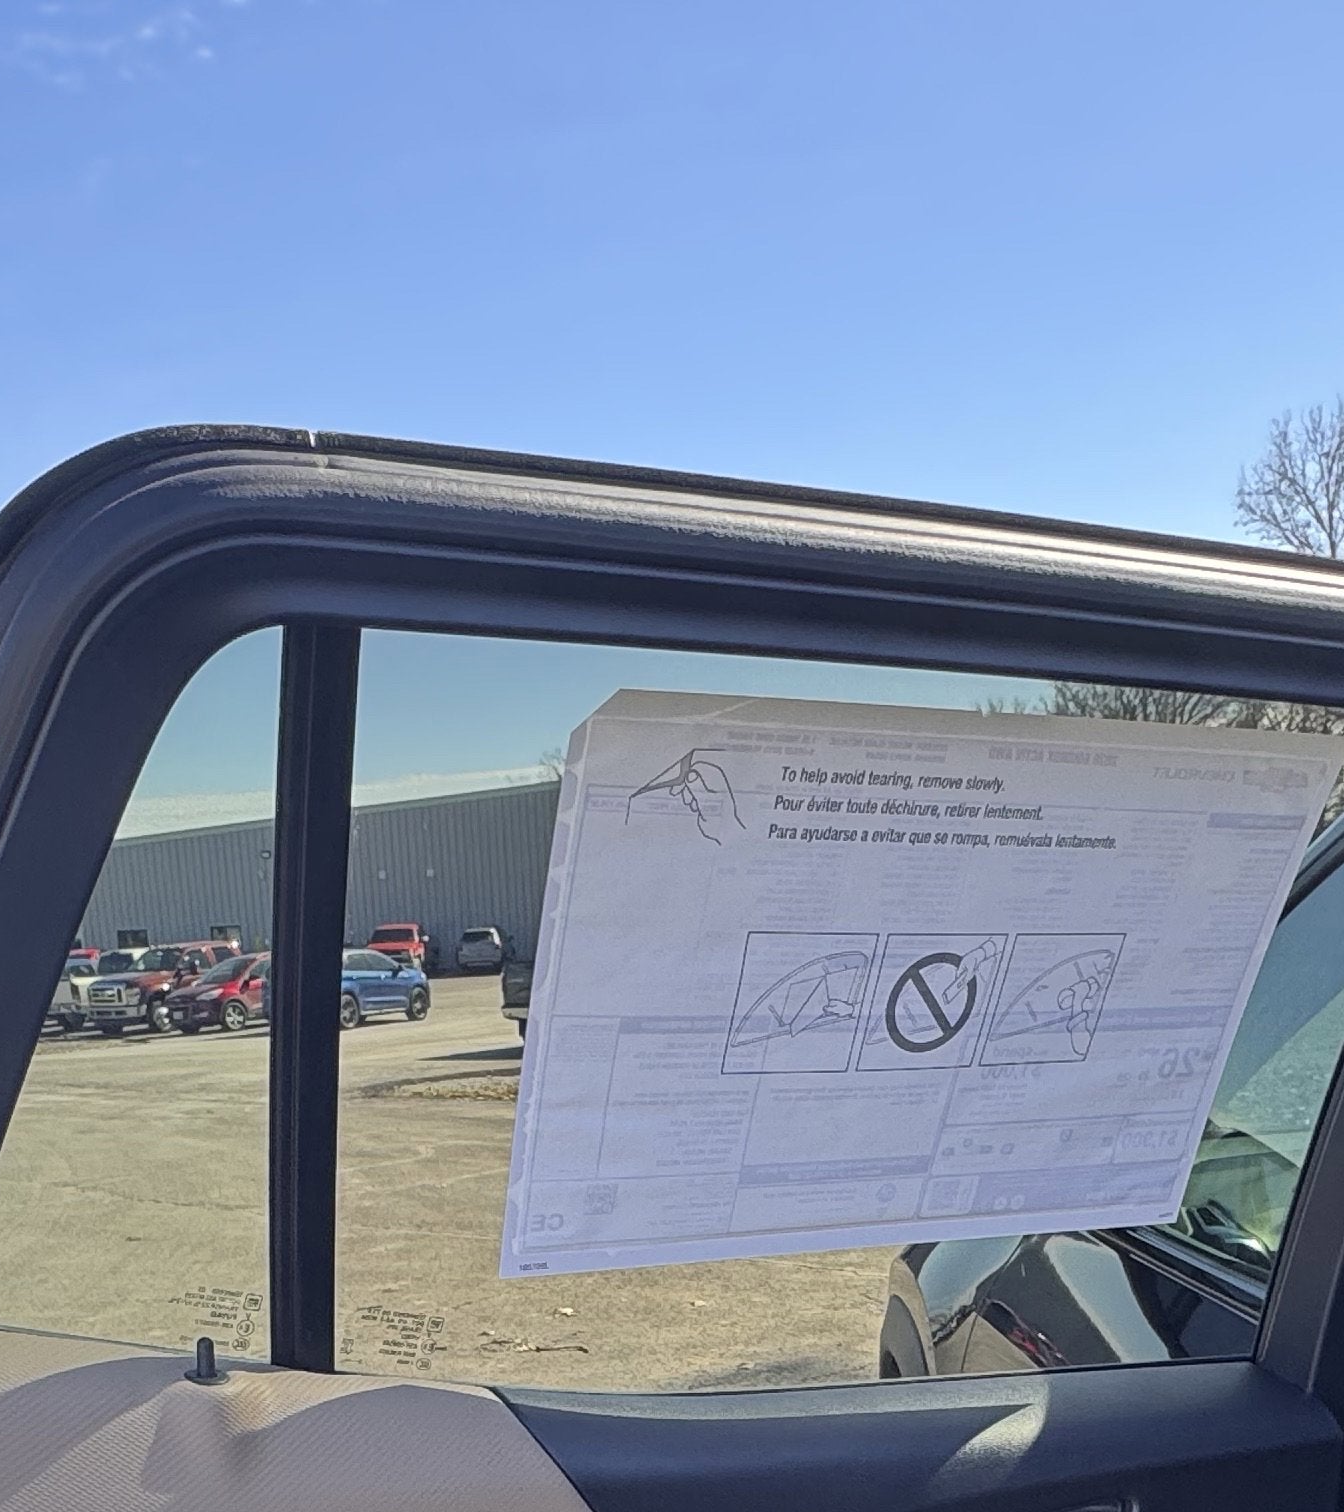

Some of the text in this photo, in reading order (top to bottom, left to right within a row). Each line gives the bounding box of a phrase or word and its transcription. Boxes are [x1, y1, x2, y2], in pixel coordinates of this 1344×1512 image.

[782, 766, 1005, 794] To help avoid tearing, remove slowly.
[774, 795, 1044, 821] Pour éviter toute déchirure, retirer lentement.
[768, 824, 797, 840] Para
[800, 827, 857, 843] ayudarse
[861, 830, 869, 842] a
[872, 828, 906, 843] evitar
[909, 832, 931, 846] que
[934, 832, 948, 845] se
[950, 833, 991, 849] rompa,
